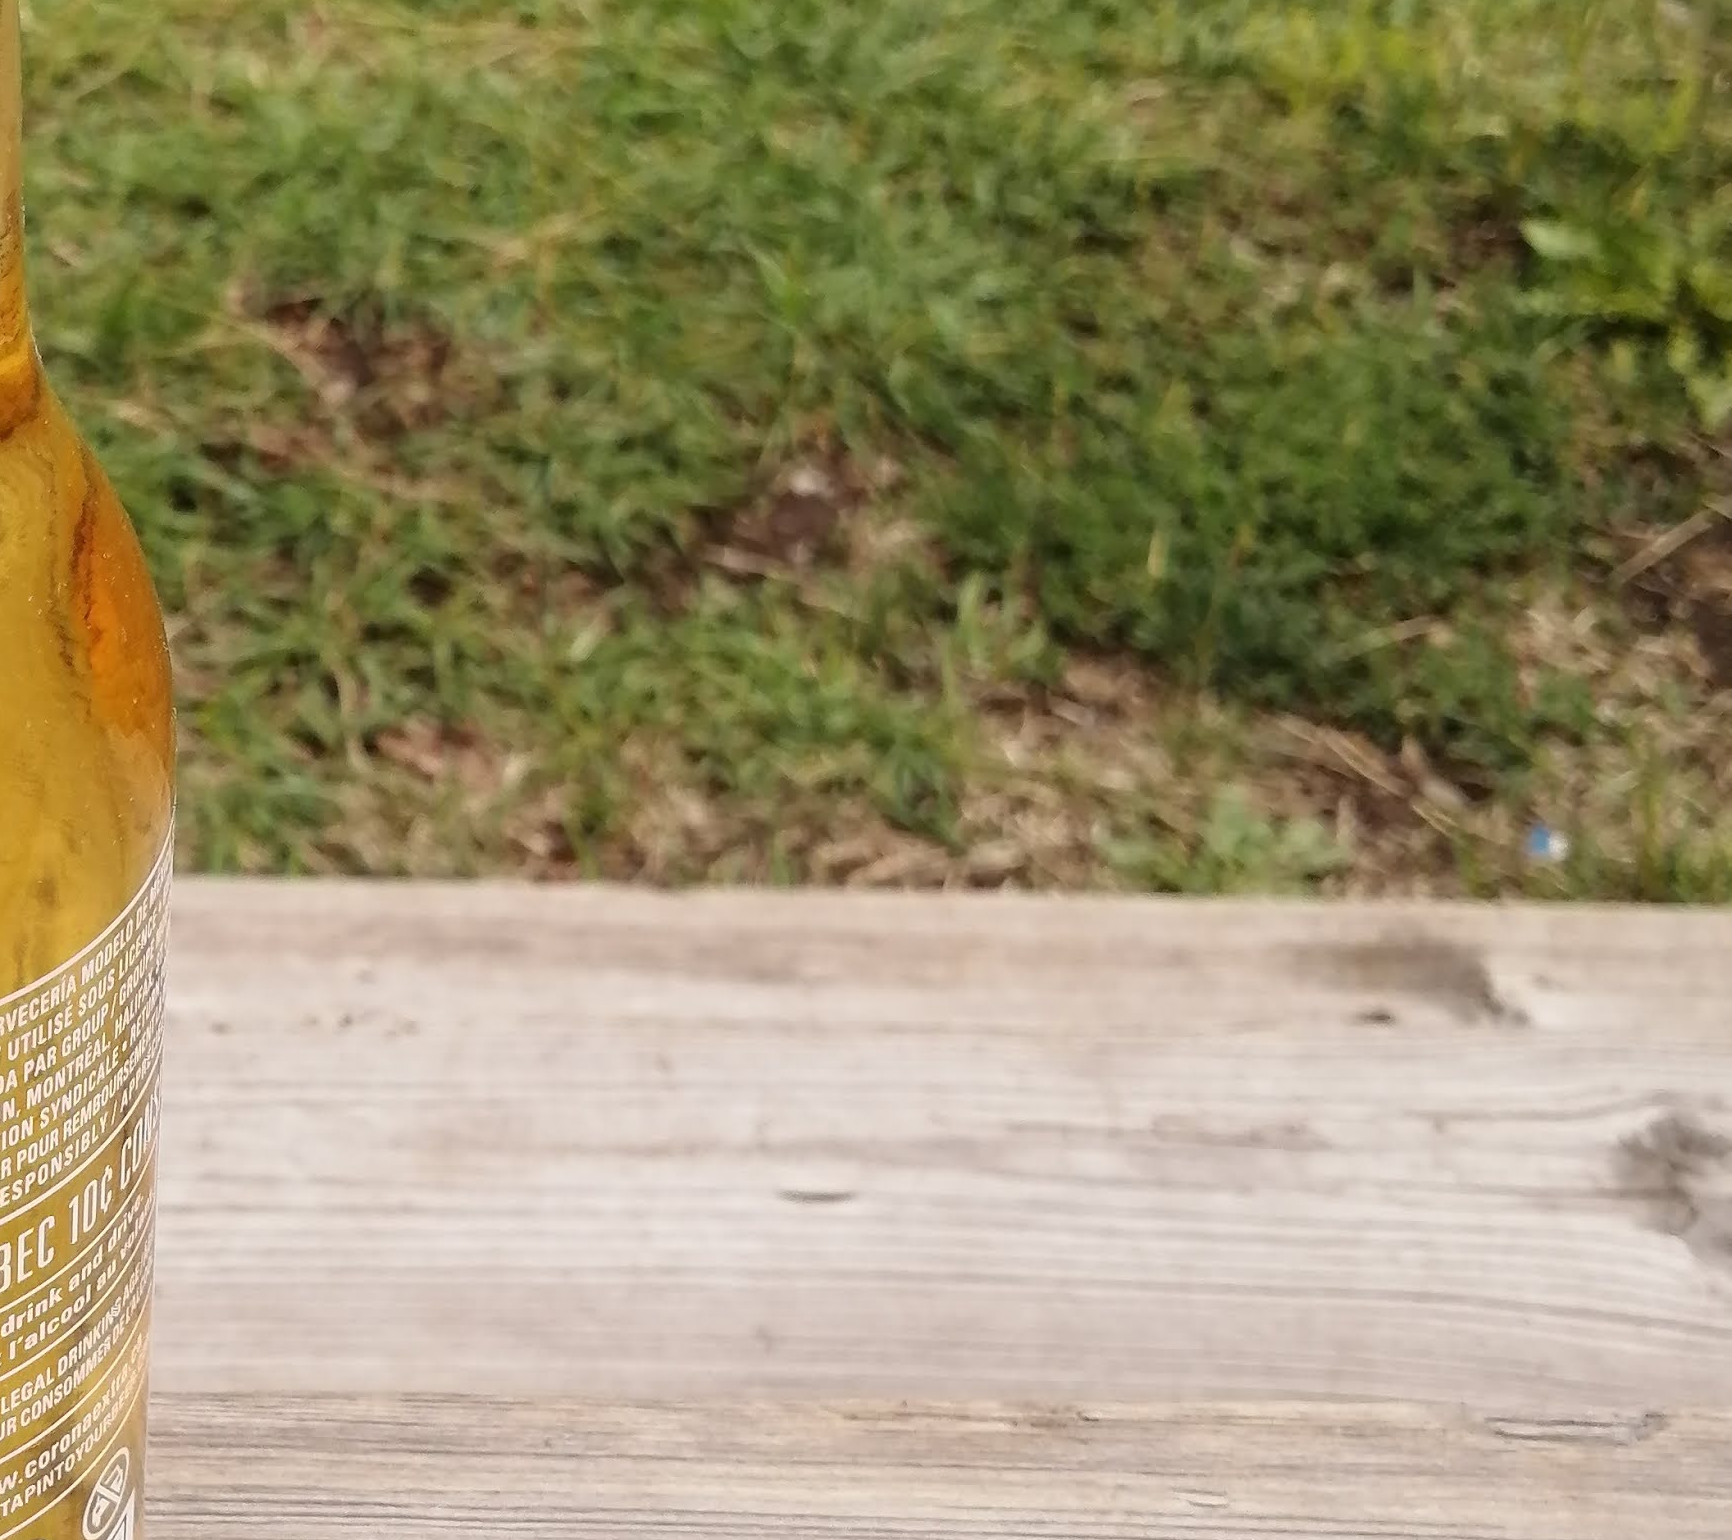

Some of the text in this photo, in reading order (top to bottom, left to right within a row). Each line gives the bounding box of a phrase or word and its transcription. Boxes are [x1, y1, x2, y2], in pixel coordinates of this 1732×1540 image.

[8, 1000, 73, 1061] UTILISÉ
[78, 969, 115, 1017] SOUS
[119, 913, 157, 980] LICENCE
[81, 918, 133, 985] MODELO
[136, 896, 149, 931] DE
[24, 1045, 57, 1083] PAR
[61, 1003, 109, 1057] GROUP
[119, 938, 155, 1006] GROUPE
[26, 1032, 112, 1109] MONTRÉAL,
[39, 1045, 119, 1129] SYNDICALE
[17, 1128, 59, 1172] POUR
[68, 1164, 113, 1245] 10¢
[0, 1287, 63, 1340] drink
[69, 1243, 104, 1292] and
[9, 1283, 91, 1360] l'alcool
[96, 1258, 117, 1292] au
[0, 1365, 55, 1425] LEGAL
[57, 1296, 123, 1377] DRINKING
[20, 1334, 111, 1427] CONSOMMER
[112, 1318, 125, 1346] DE
